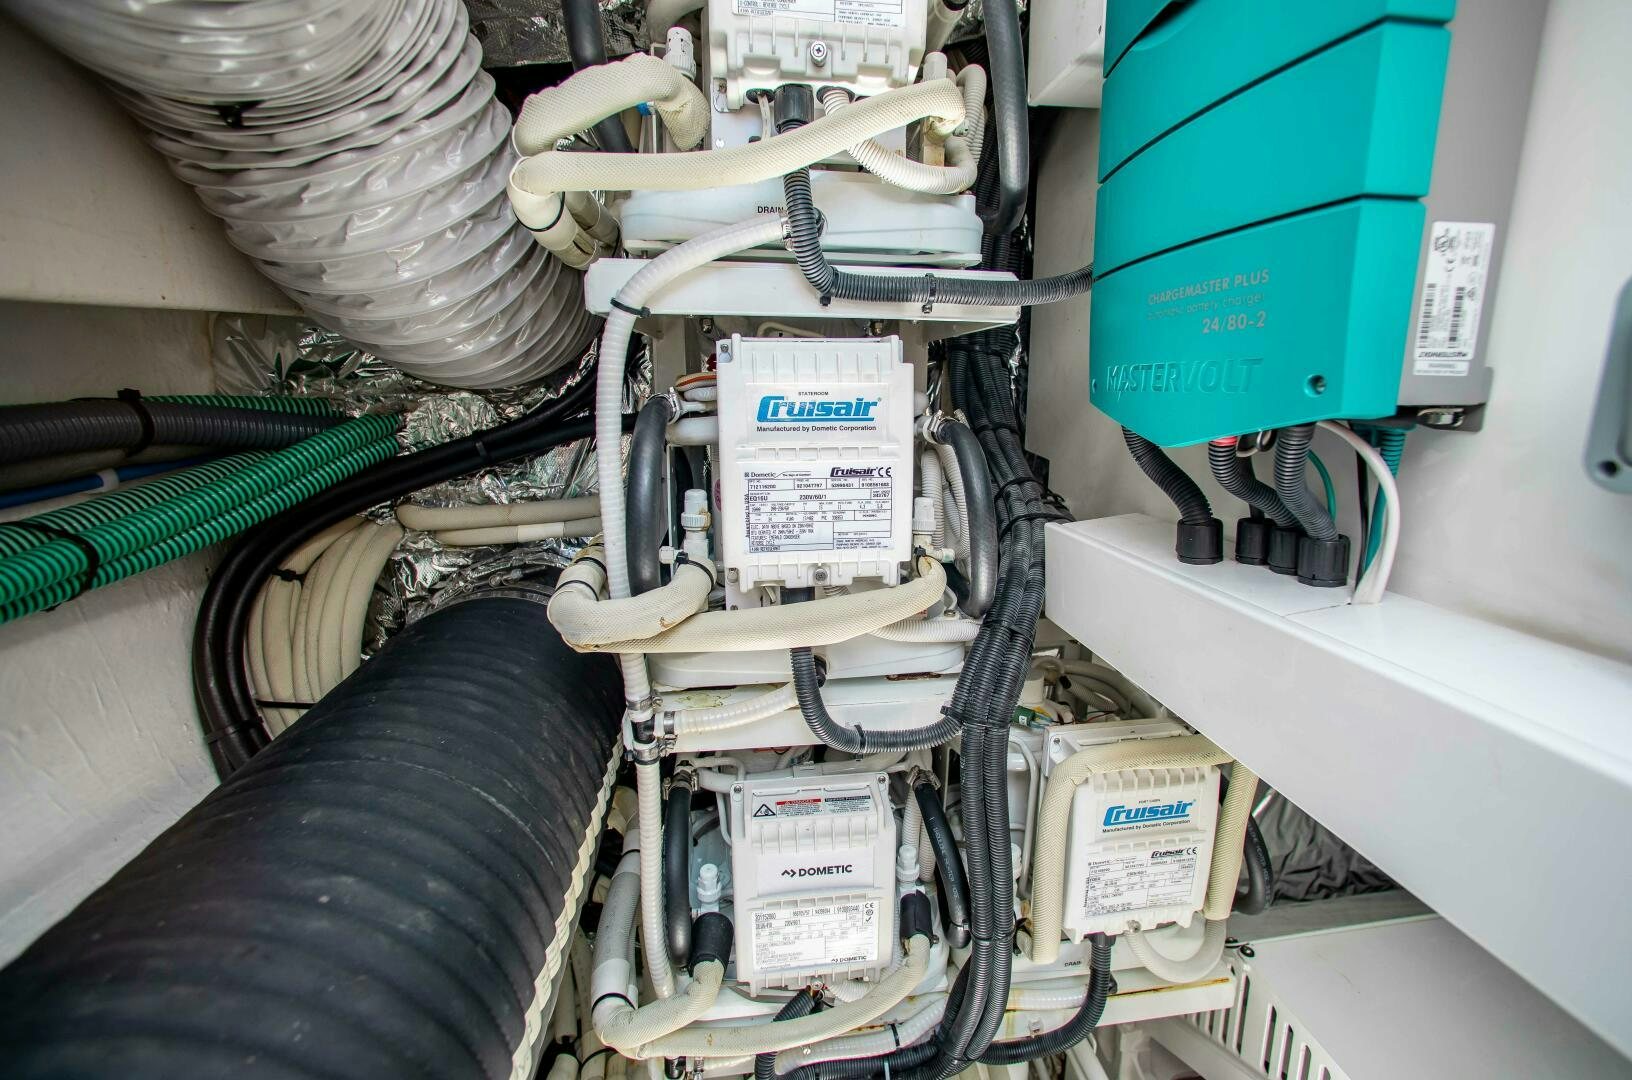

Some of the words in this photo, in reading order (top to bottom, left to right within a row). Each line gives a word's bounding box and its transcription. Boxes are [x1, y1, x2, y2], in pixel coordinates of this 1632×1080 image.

[757, 206, 784, 214] DRAIN
[1148, 277, 1230, 305] CHARGEMASTER
[1233, 268, 1270, 288] PLUS
[1201, 310, 1266, 334] 24/80-2
[1106, 358, 1264, 395] MASTERVOLT
[757, 395, 880, 423] Cruisair
[839, 424, 877, 432] Corporation
[1103, 800, 1193, 827] Cruisair
[1102, 825, 1135, 833] Manufactured
[1162, 819, 1191, 827] Corporation
[798, 864, 853, 877] DOMETIC
[839, 955, 867, 963] DOMETIC
